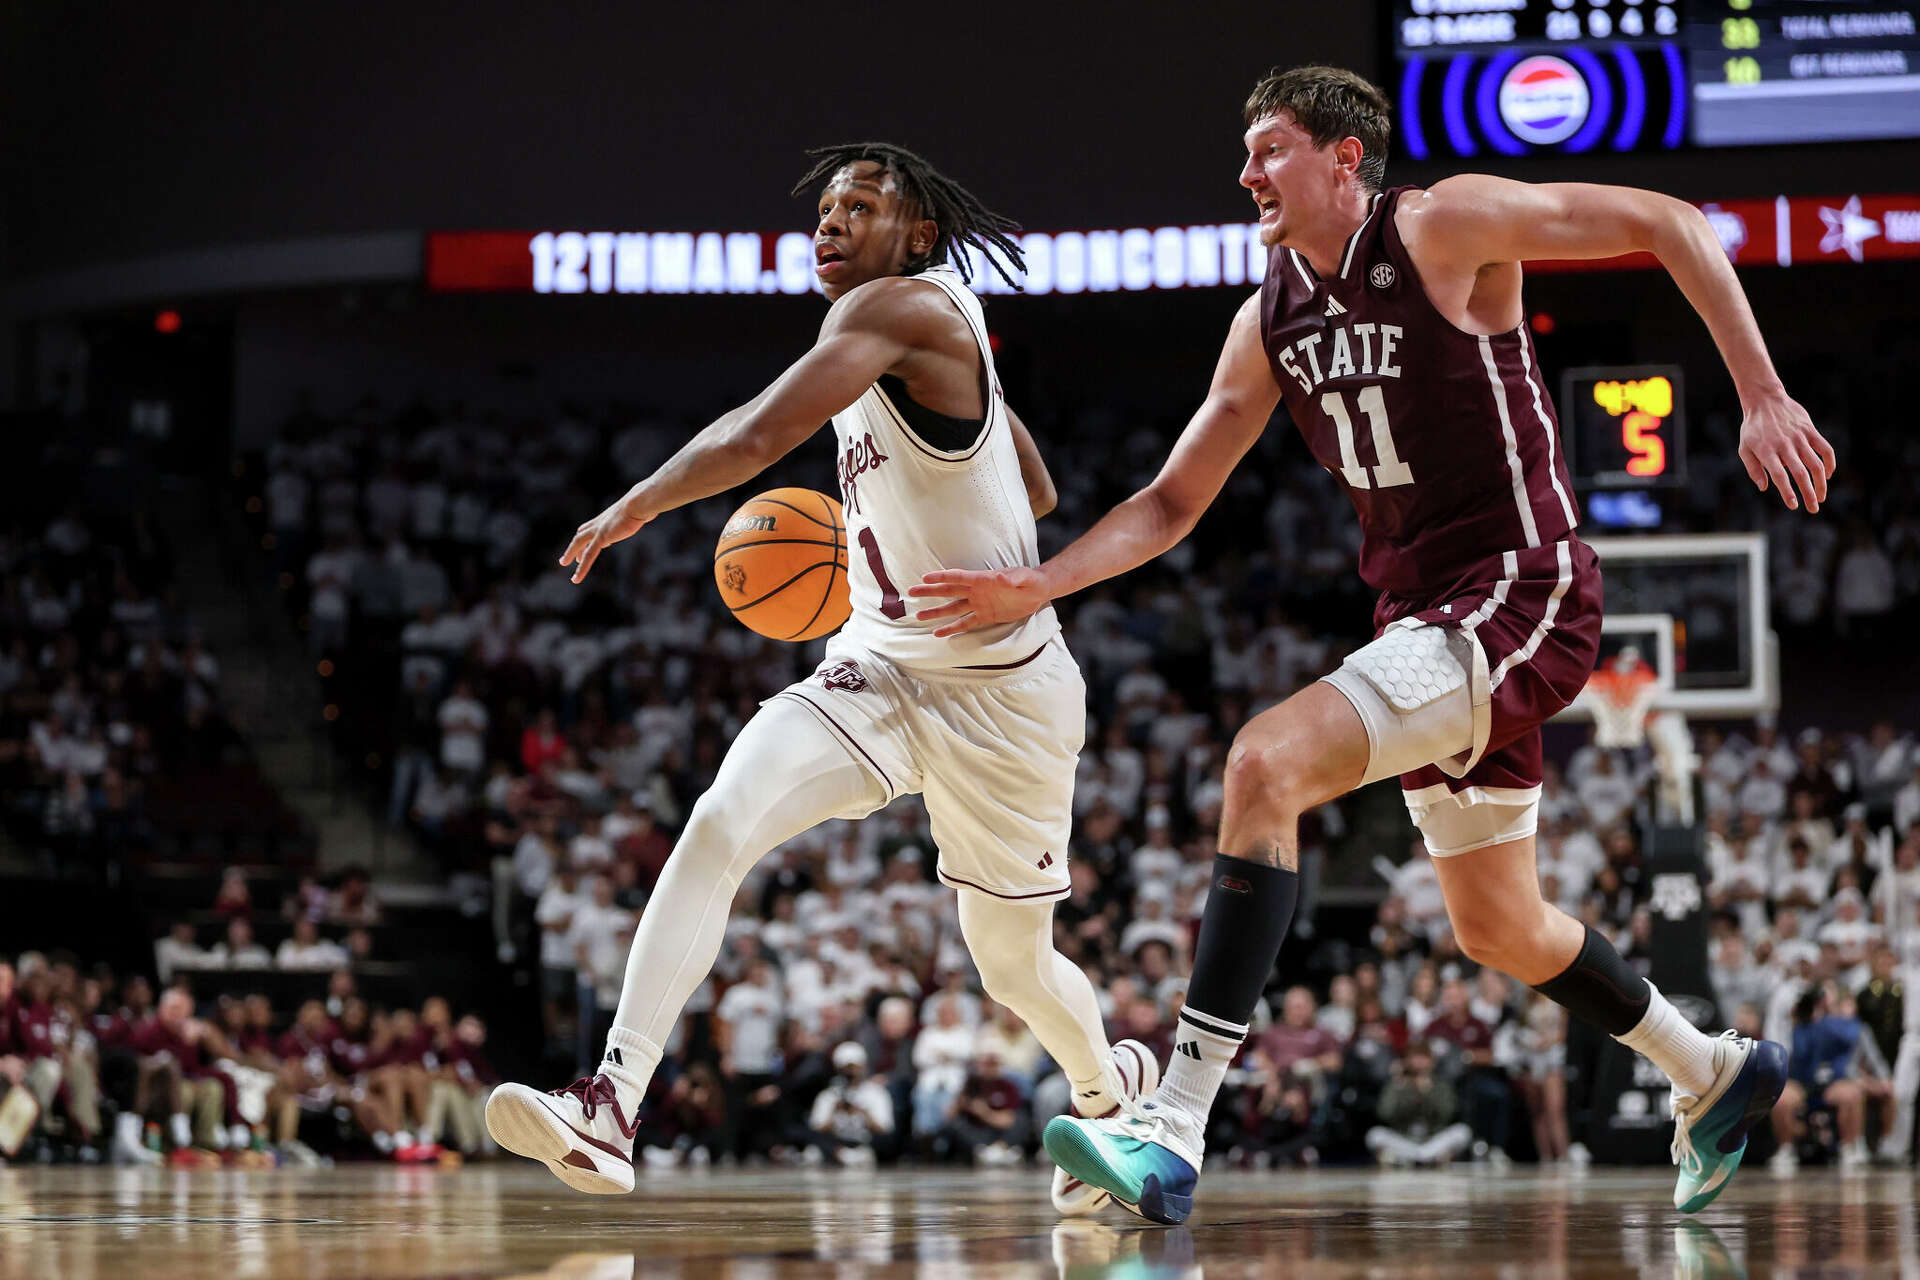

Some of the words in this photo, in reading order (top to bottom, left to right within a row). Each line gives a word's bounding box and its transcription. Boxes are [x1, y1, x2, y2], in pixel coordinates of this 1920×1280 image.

[530, 231, 838, 294] 12THMAN.C
[1373, 267, 1393, 286] SEC
[1278, 322, 1404, 396] STATE
[1320, 384, 1416, 490] 11
[1622, 411, 1666, 477] 5
[857, 526, 907, 621] 1
